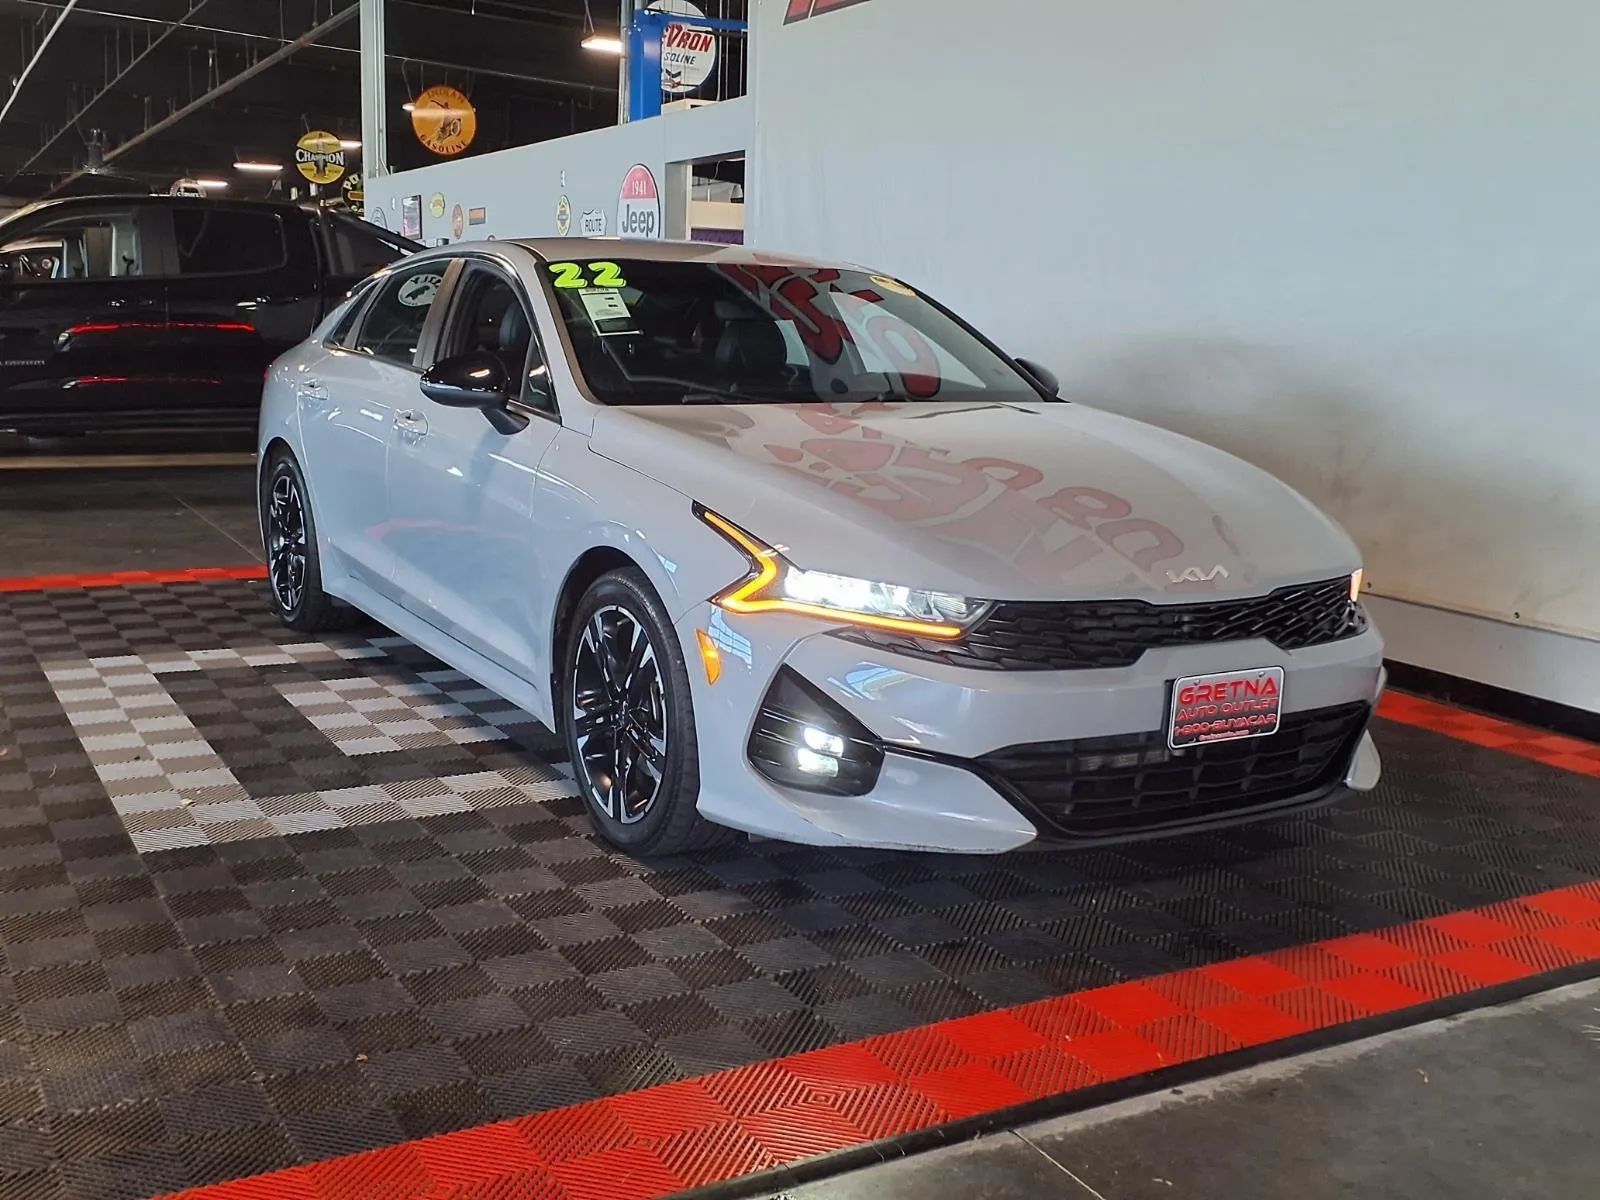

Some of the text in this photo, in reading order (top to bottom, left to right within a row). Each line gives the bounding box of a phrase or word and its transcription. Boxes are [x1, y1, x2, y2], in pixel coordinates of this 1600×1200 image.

[664, 24, 713, 53] VRON
[664, 52, 697, 65] SOLINE
[632, 179, 647, 196] 1941
[584, 218, 603, 233] ROUTE
[622, 204, 655, 238] Jeep
[548, 261, 627, 289] 22
[1179, 677, 1278, 706] GRETNA
[1177, 697, 1279, 721] AUTO OUTLET
